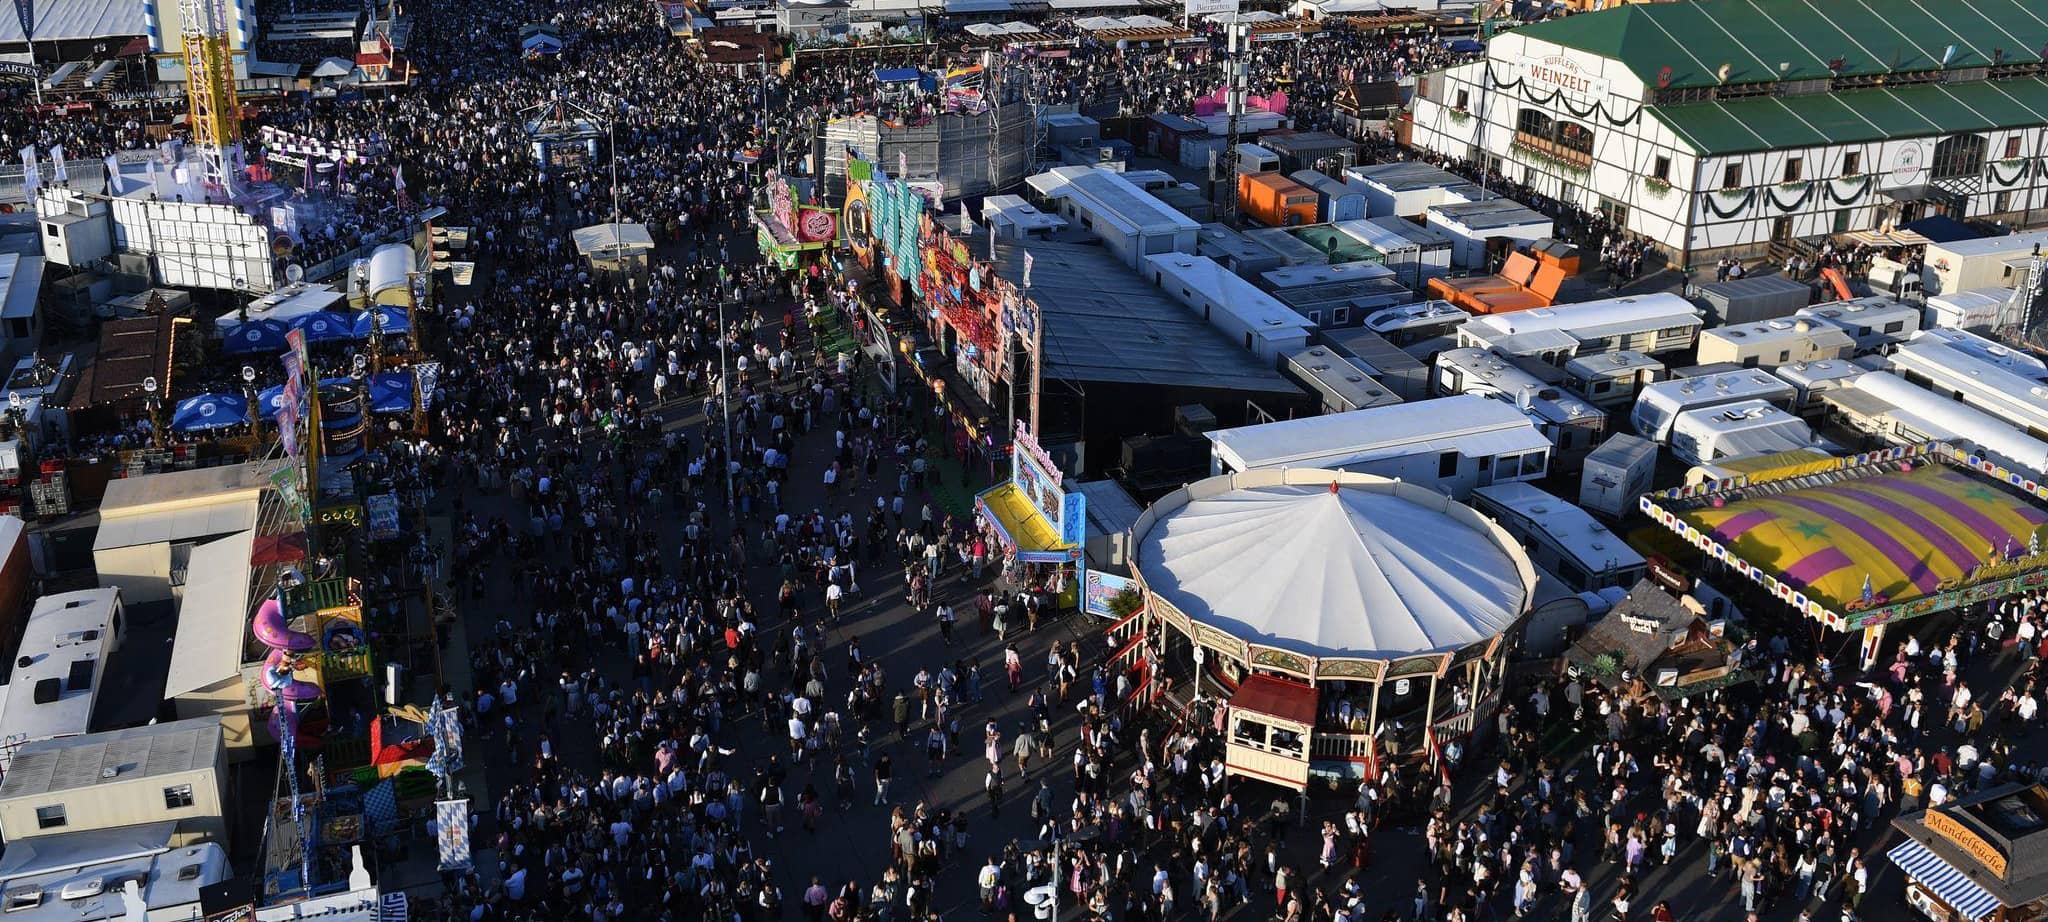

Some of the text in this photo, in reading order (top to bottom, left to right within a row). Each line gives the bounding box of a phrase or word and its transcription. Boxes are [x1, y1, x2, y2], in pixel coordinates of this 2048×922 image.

[1544, 57, 1579, 75] KUFFLERS
[1531, 64, 1592, 94] WEINZELT
[1620, 613, 1660, 628] Bratwurst
[1927, 813, 2004, 871] Mandelküche
